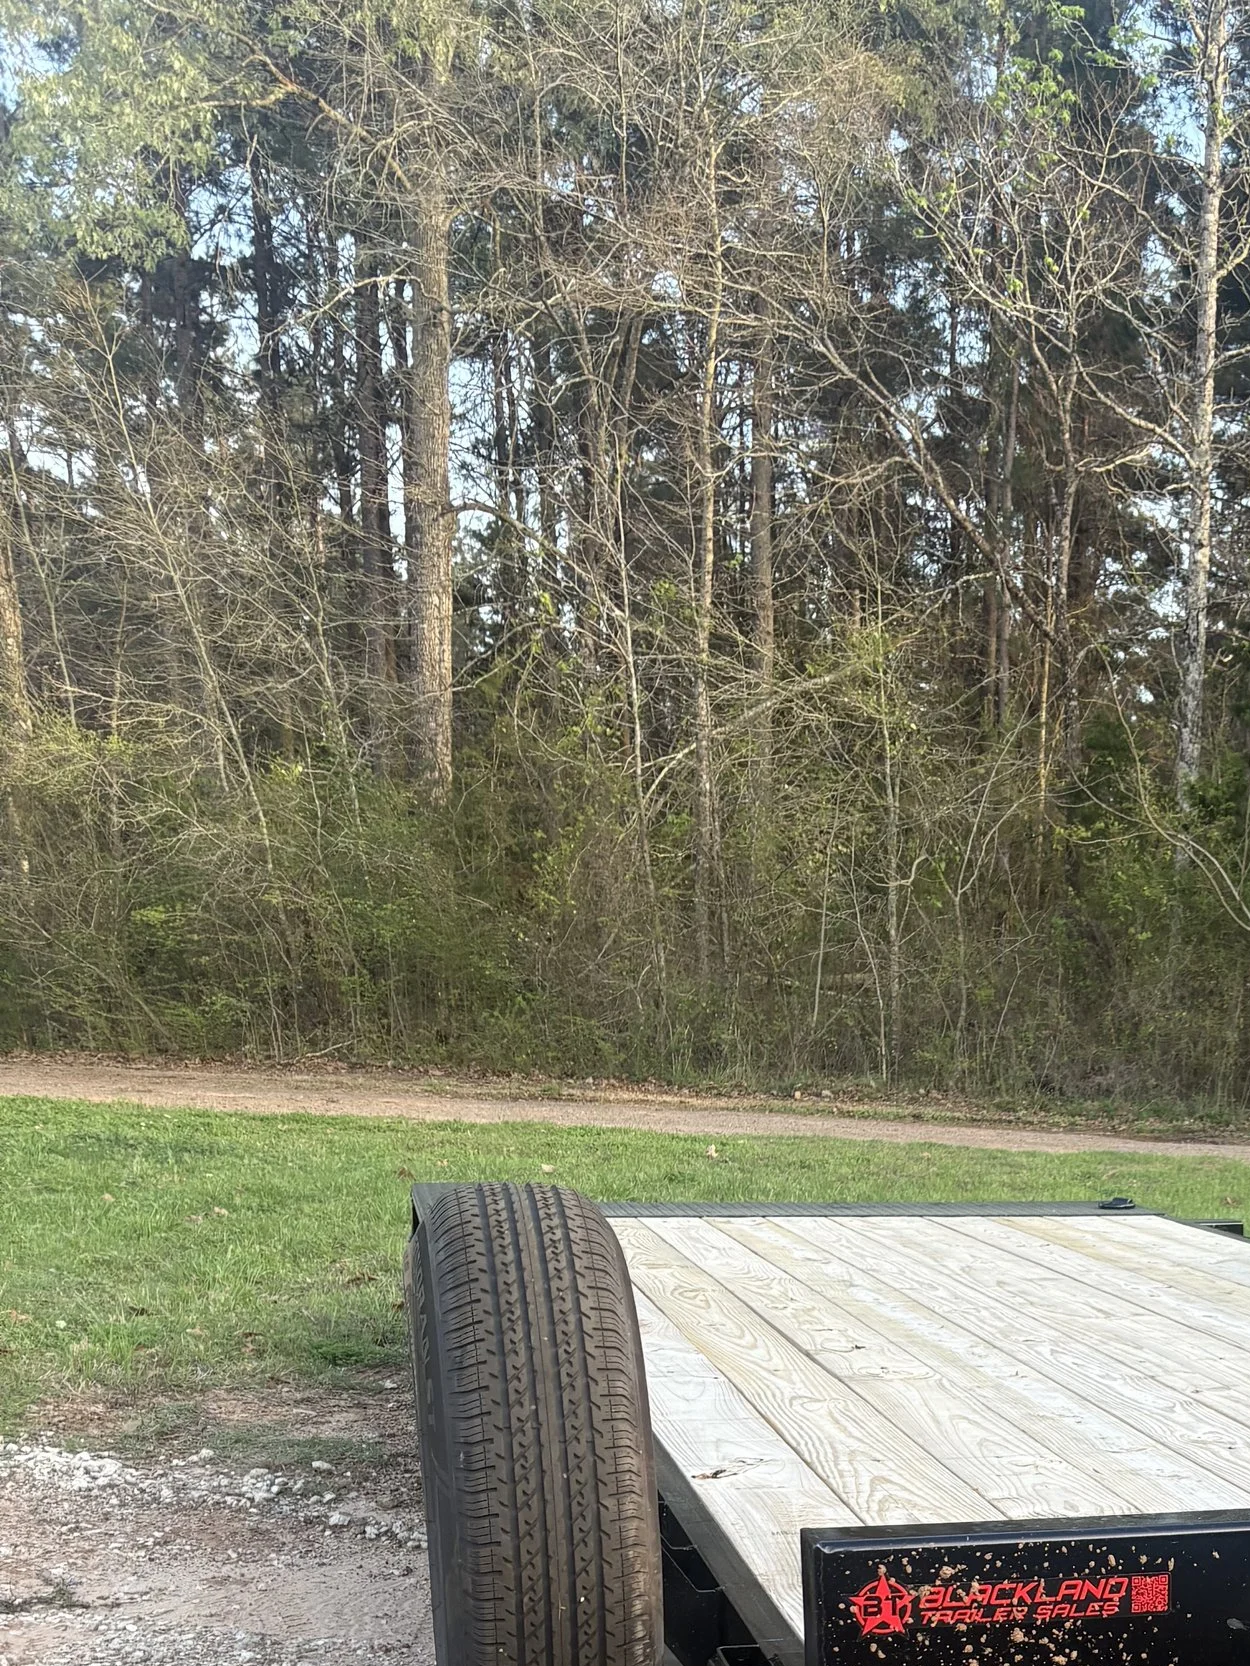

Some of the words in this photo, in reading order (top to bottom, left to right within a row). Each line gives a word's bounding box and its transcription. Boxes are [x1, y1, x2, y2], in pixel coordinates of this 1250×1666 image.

[919, 1577, 1129, 1609] BLACKLAND
[920, 1606, 1029, 1626] TRAILER
[1037, 1601, 1119, 1621] SALES
